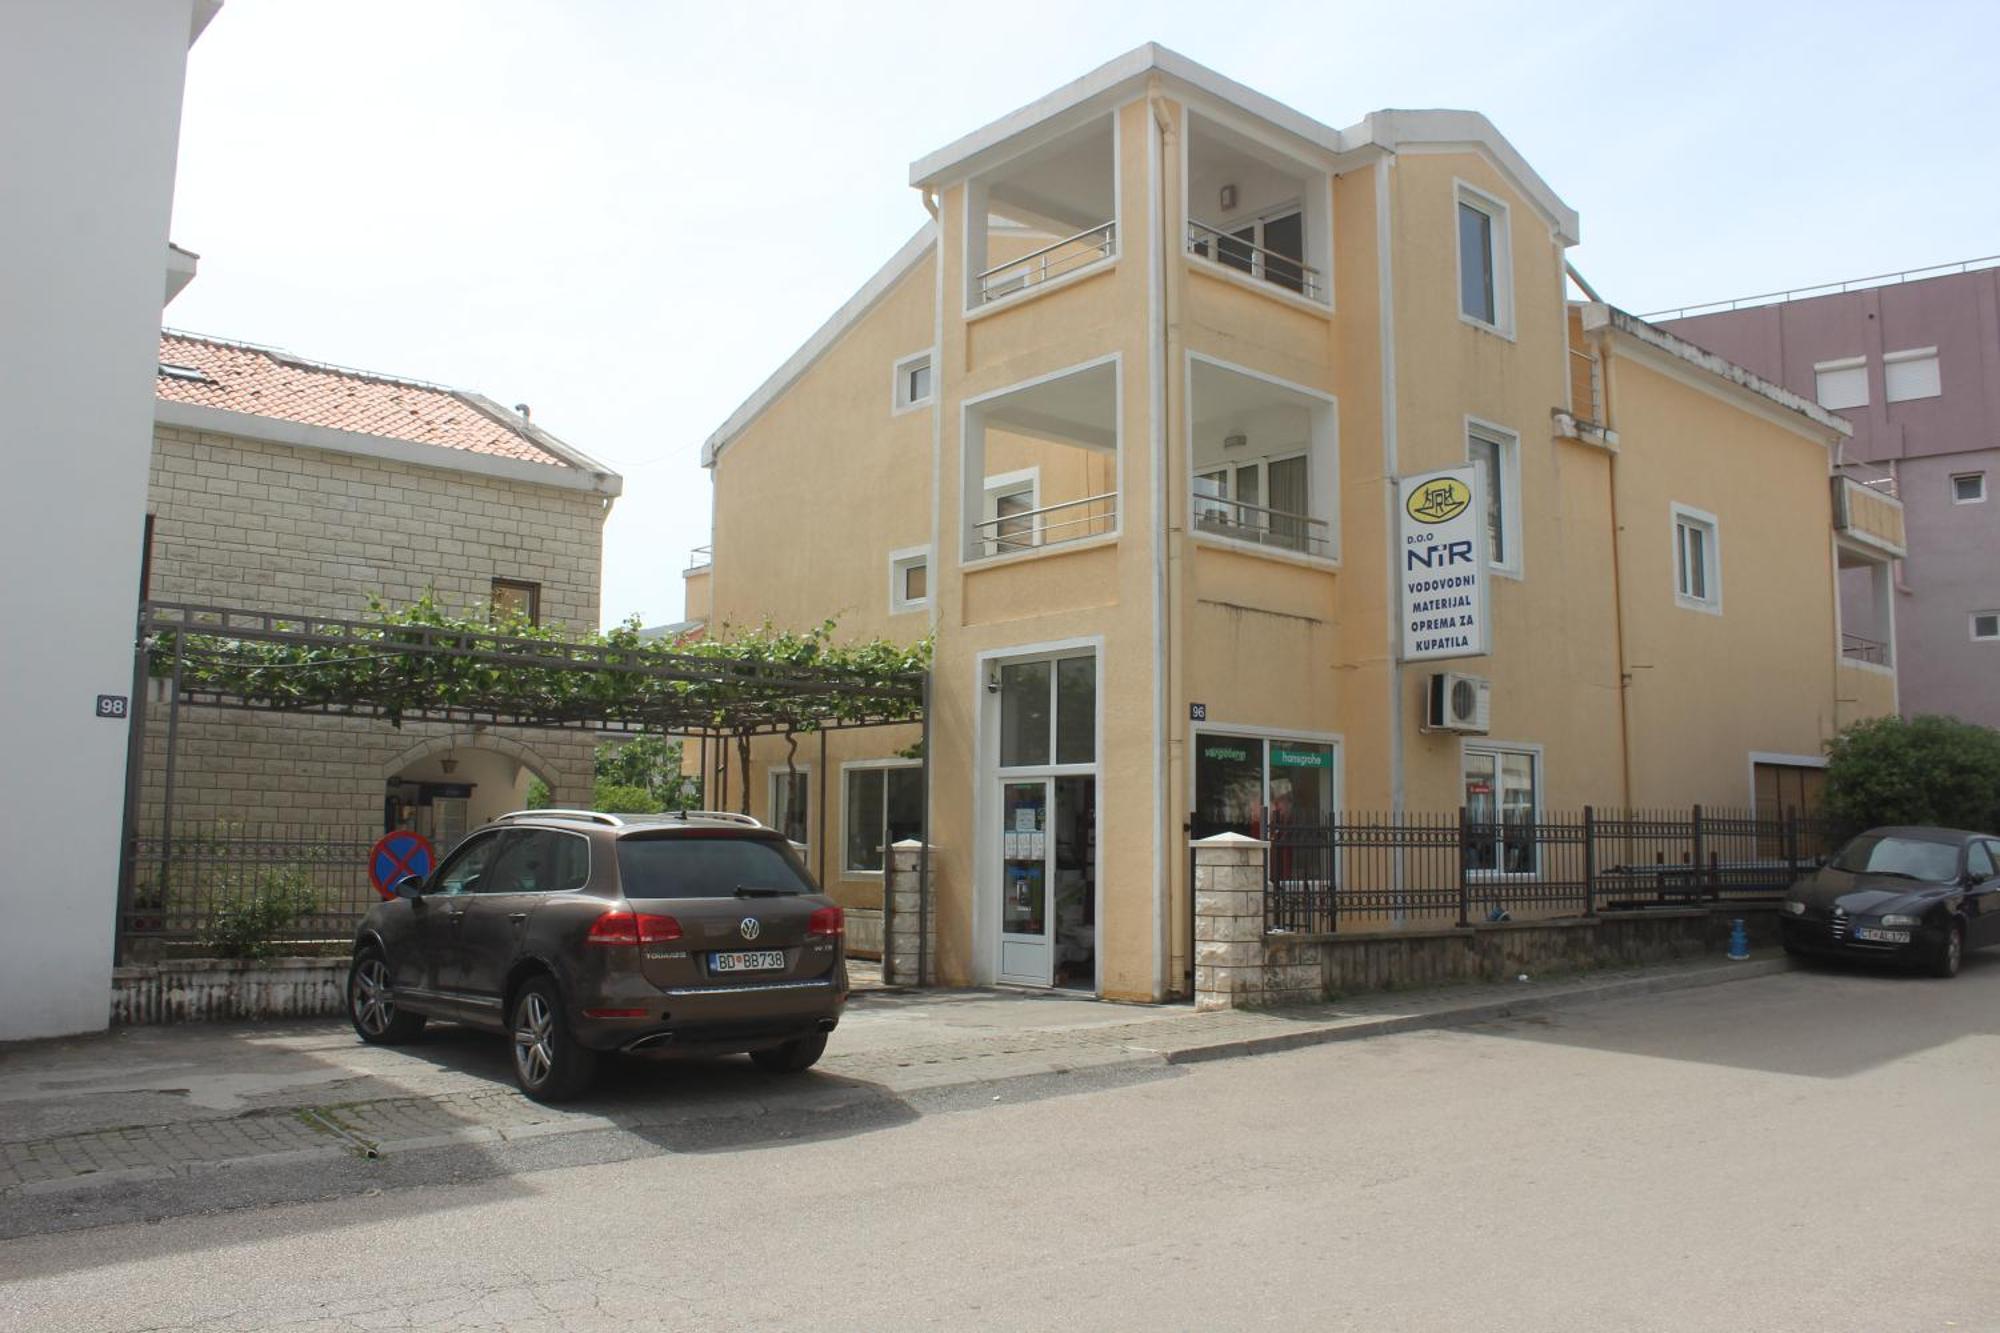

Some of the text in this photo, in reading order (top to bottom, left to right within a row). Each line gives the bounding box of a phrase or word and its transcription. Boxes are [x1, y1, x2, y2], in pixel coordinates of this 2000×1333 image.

[1407, 532, 1434, 545] D.O.O
[1408, 574, 1475, 594] VODOVODNI
[1412, 595, 1471, 614] MATERIJAL
[1411, 615, 1474, 633] OPREMA ZA
[1415, 635, 1469, 652] KUPATILA
[101, 699, 124, 714] 98
[1192, 706, 1205, 718] 96
[719, 952, 783, 970] BD BB738
